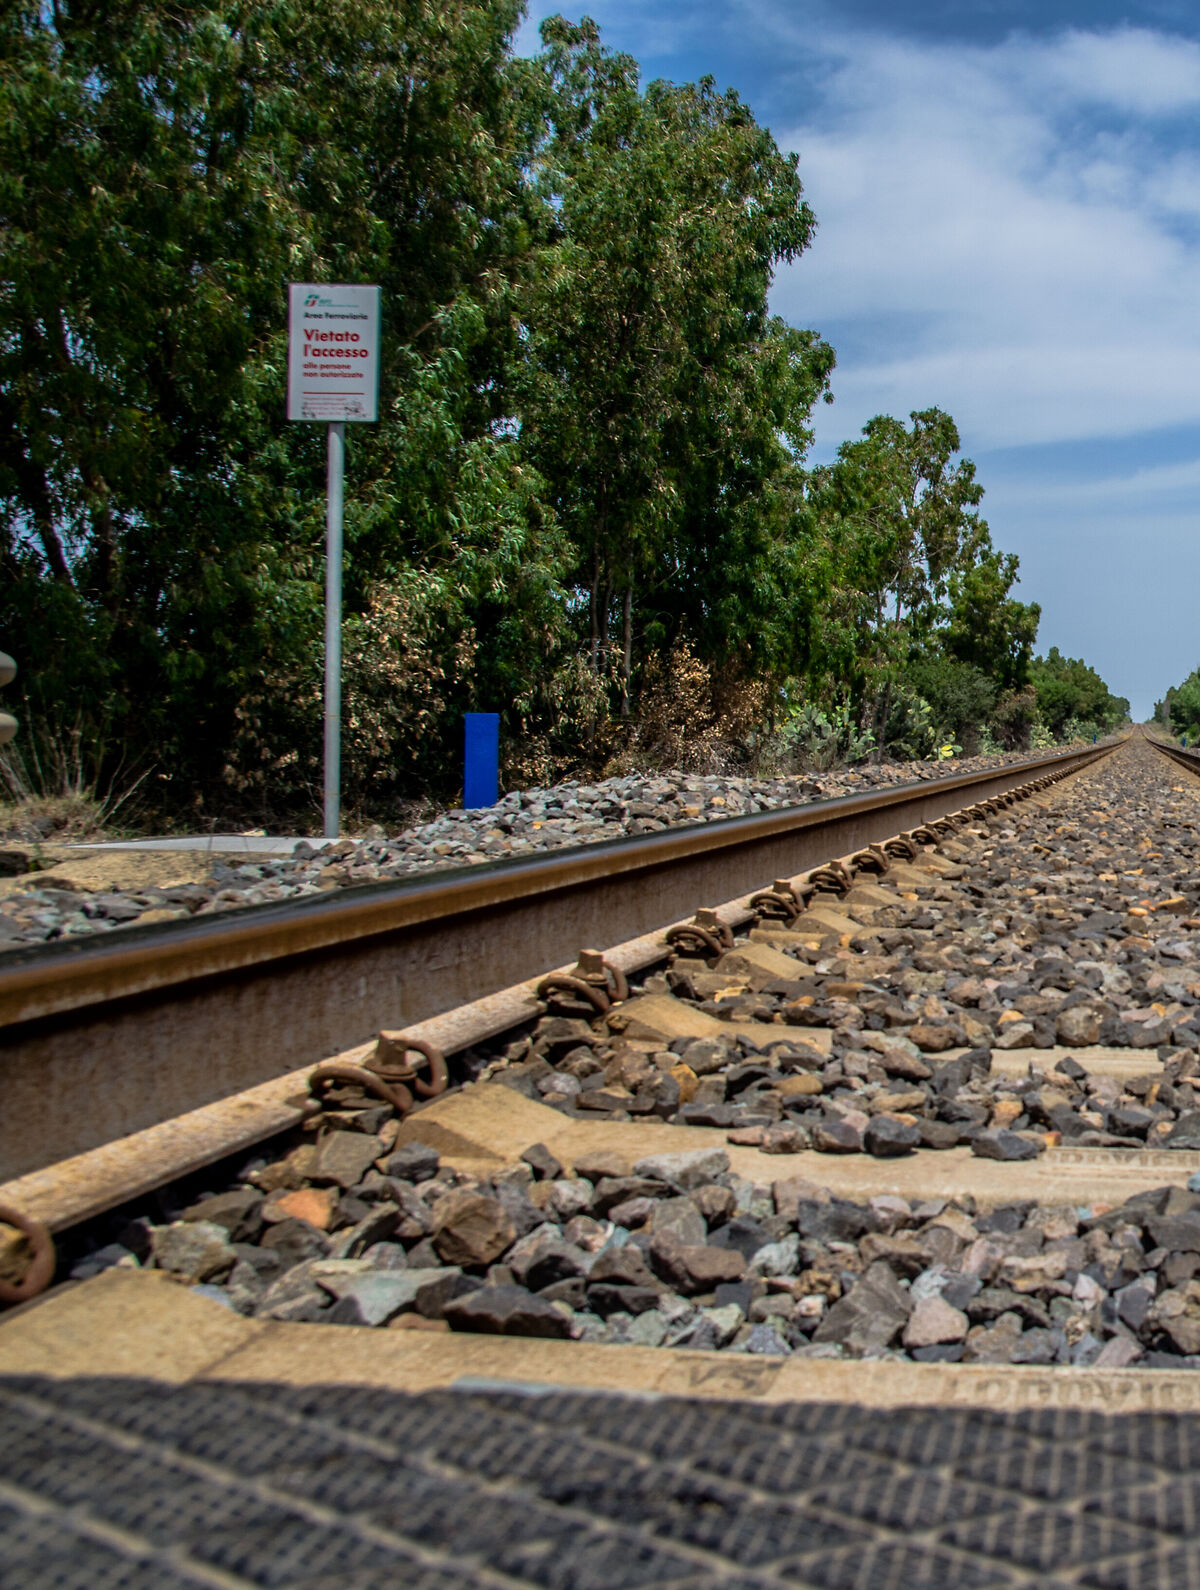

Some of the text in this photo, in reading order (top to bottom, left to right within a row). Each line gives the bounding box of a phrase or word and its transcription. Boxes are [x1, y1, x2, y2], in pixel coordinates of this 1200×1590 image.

[304, 312, 323, 320] Area
[304, 329, 360, 342] Vietato
[304, 344, 369, 358] l'accesso
